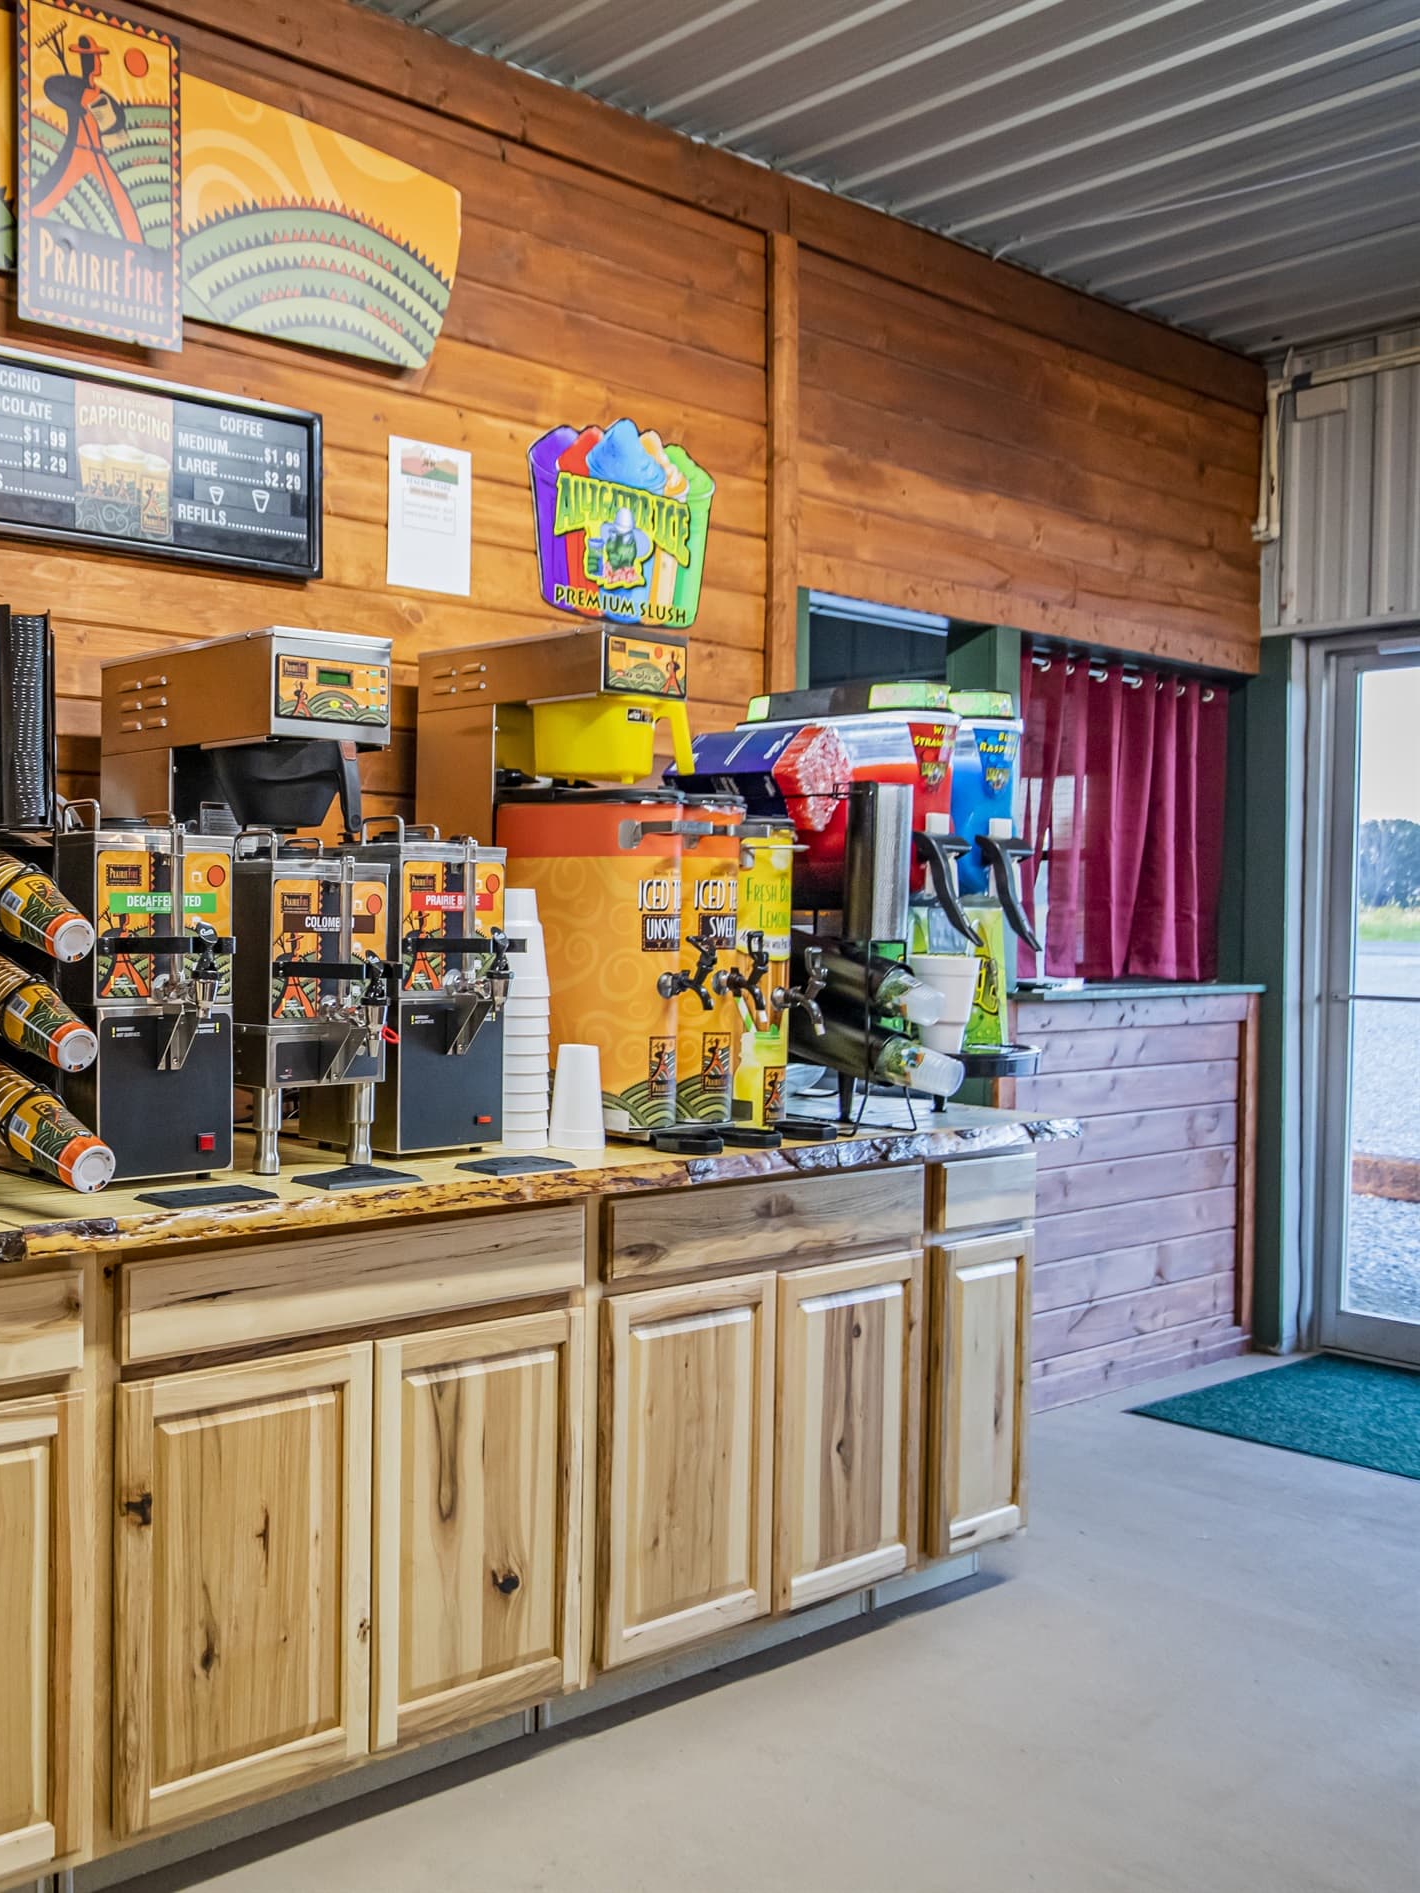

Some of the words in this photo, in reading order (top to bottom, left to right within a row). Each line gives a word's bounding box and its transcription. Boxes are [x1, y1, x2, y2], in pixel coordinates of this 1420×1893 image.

[39, 227, 119, 297] PRAIRIE
[124, 250, 164, 307] FIRE
[39, 284, 85, 307] COFFEE
[103, 300, 164, 325] ROASTERS
[79, 405, 171, 442] CAPPUCCINO
[220, 415, 264, 439] COFFEE
[23, 425, 67, 449] $1.99
[177, 431, 229, 456] MEDIUM
[23, 450, 67, 474] $2.29
[178, 455, 219, 477] LARGE
[177, 503, 227, 526] REFILLS
[655, 500, 687, 563] ICE
[555, 586, 635, 616] PREMIUM
[640, 602, 687, 624] SLUSH
[425, 895, 456, 906] PRAIRIE
[638, 880, 671, 911] ICED
[694, 880, 727, 910] ICED
[746, 877, 777, 902] FRESH
